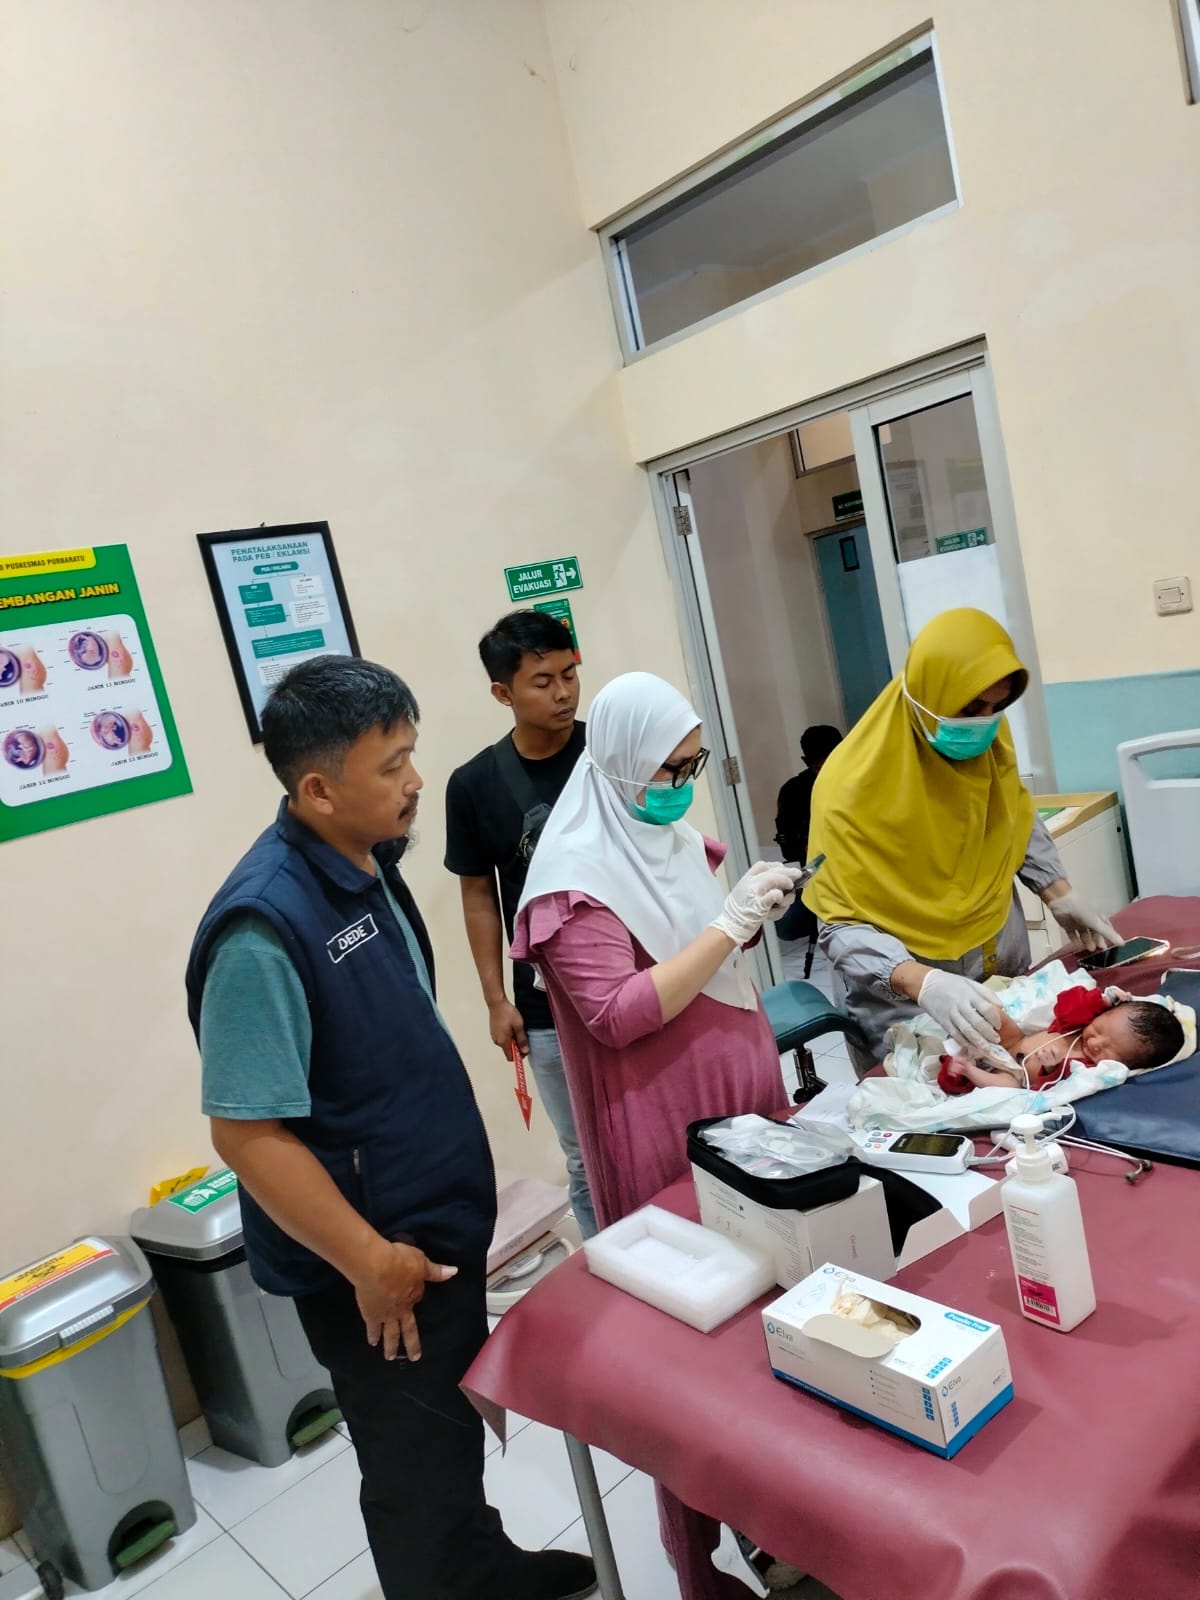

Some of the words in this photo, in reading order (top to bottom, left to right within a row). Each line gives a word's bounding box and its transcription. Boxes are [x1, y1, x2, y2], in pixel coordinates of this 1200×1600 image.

[231, 542, 308, 556] PENATALAKSANAAN
[232, 554, 253, 563] PADA
[255, 551, 271, 560] PEB
[277, 548, 310, 558] EKLAMSI
[5, 559, 46, 570] PUSKESMAS
[518, 569, 543, 582] JALUR
[79, 583, 120, 598] JANIN
[513, 579, 552, 594] EVAKUASI
[338, 925, 368, 950] DEDE
